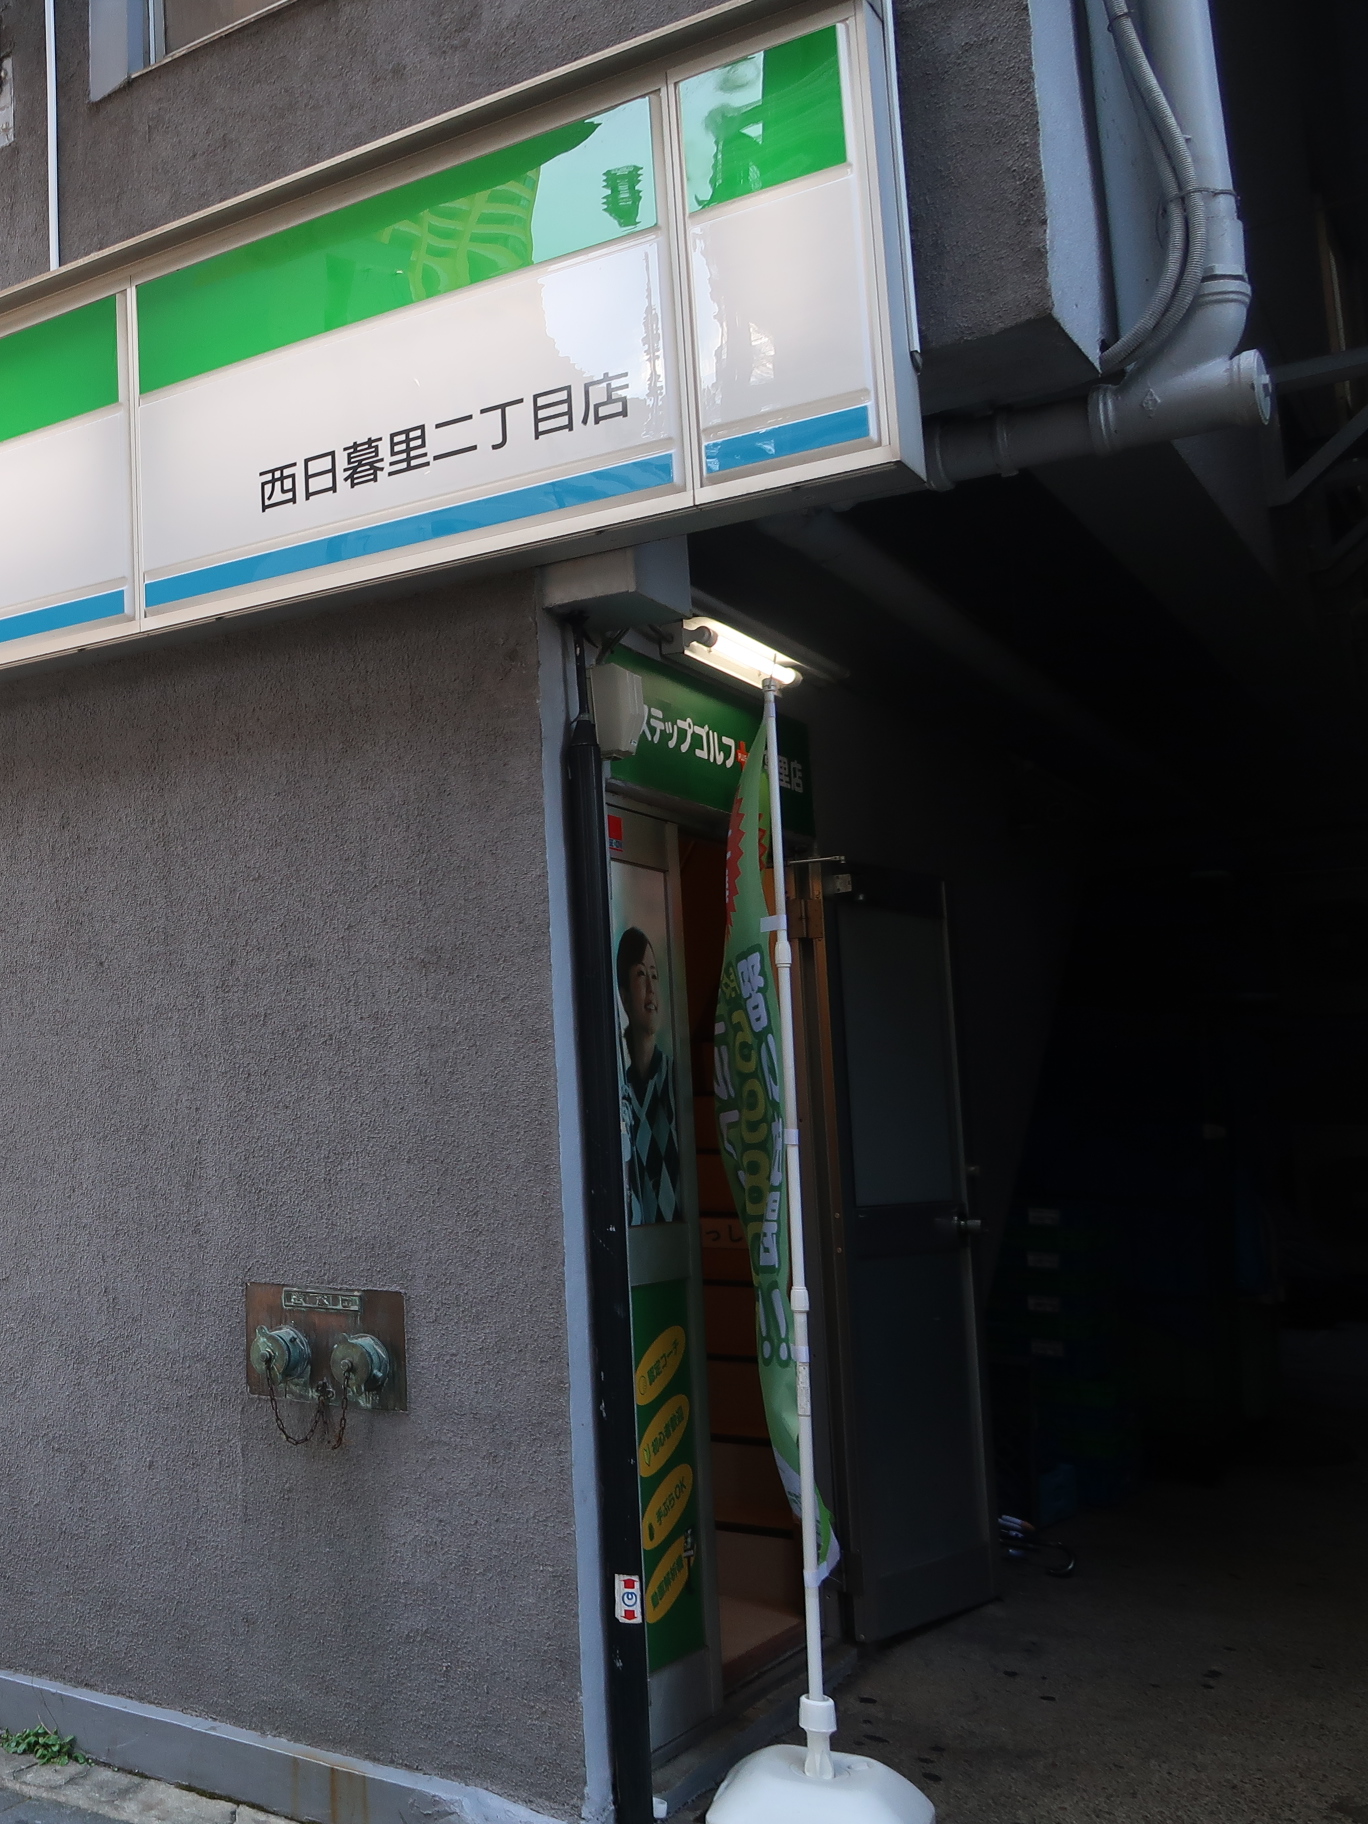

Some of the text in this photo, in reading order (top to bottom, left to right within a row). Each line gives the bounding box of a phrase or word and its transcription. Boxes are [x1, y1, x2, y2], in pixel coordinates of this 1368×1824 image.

[258, 371, 629, 512] 西日暮里二丁目店
[655, 1475, 688, 1526] 手ぶらOK
